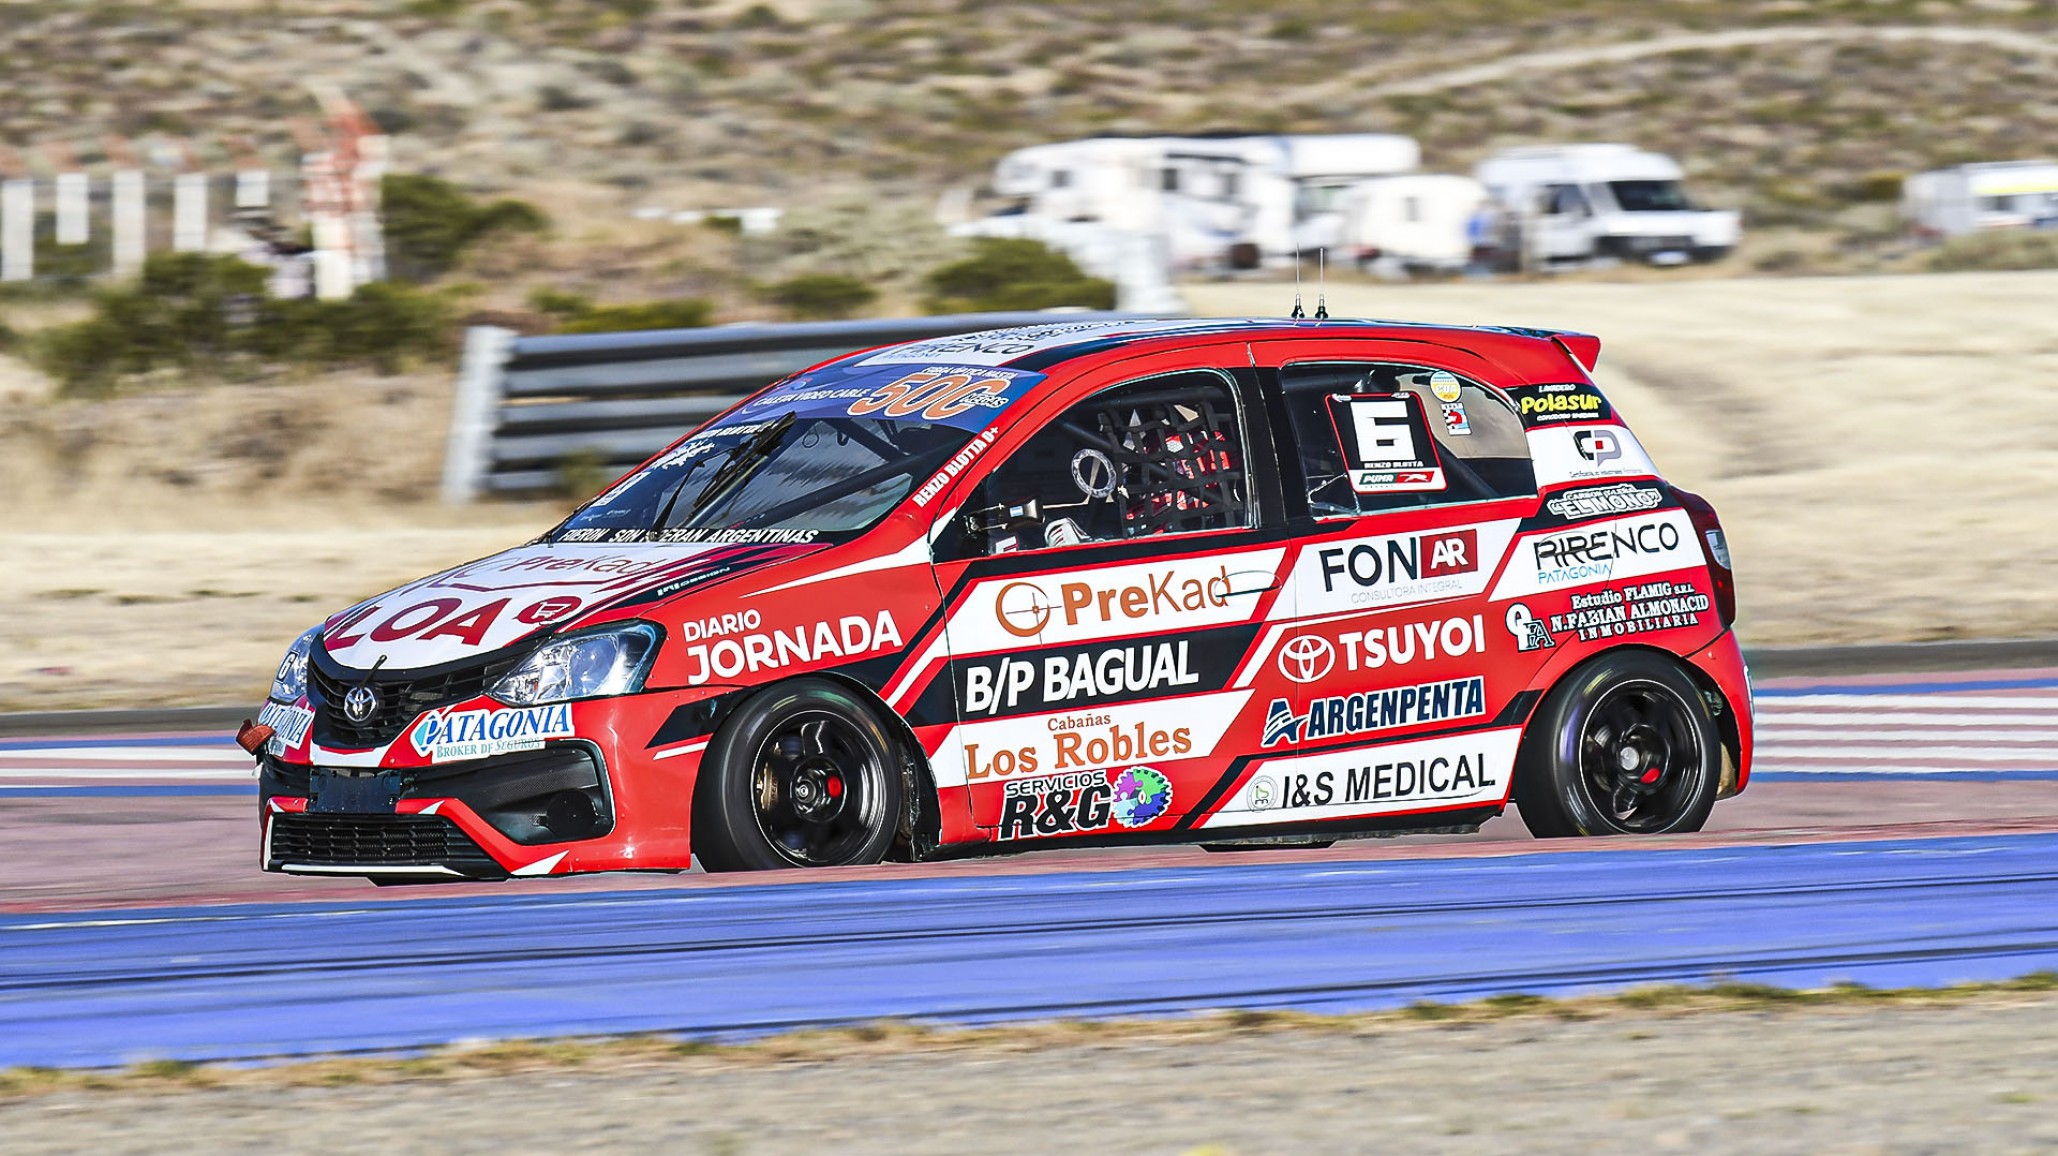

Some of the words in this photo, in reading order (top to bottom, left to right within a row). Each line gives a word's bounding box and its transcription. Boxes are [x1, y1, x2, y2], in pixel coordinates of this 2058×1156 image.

[830, 388, 872, 399] CABLE
[1521, 394, 1602, 415] Polasur
[1350, 400, 1416, 462] 6
[912, 472, 951, 508] RENZO
[943, 438, 988, 478] BLOTTA
[557, 528, 611, 543] FUERON
[609, 528, 646, 543] SON
[704, 529, 819, 544] ARGENTINAS
[1538, 563, 1612, 585] PATAGONIA
[1060, 565, 1231, 625] PreKad
[1351, 586, 1416, 604] CONSULTORA
[1417, 579, 1463, 595] INTEGRAL
[1571, 588, 1623, 610] Estudio
[1624, 582, 1672, 600] FLAMIG
[1630, 594, 1710, 620] ALMONACID
[683, 608, 761, 642] DIARIO
[1578, 613, 1699, 641] INMOBILIARIA
[687, 609, 903, 685] JORNADA
[1338, 614, 1486, 671] TSUYOI
[278, 651, 298, 681] 6
[965, 657, 1036, 715] B/P
[1043, 640, 1199, 702] BAGUAL
[426, 702, 570, 746] PATAGONIA
[1047, 712, 1111, 732] Cabañas
[1307, 678, 1485, 738] ARGENPENTA
[436, 745, 478, 758] BROKER
[965, 743, 1038, 779] Los
[1054, 721, 1192, 769] Robles
[1005, 769, 1106, 798] SERVICIOS
[1282, 769, 1334, 809] I&S
[1345, 752, 1496, 802] MEDICAL
[999, 782, 1114, 841] R&G
